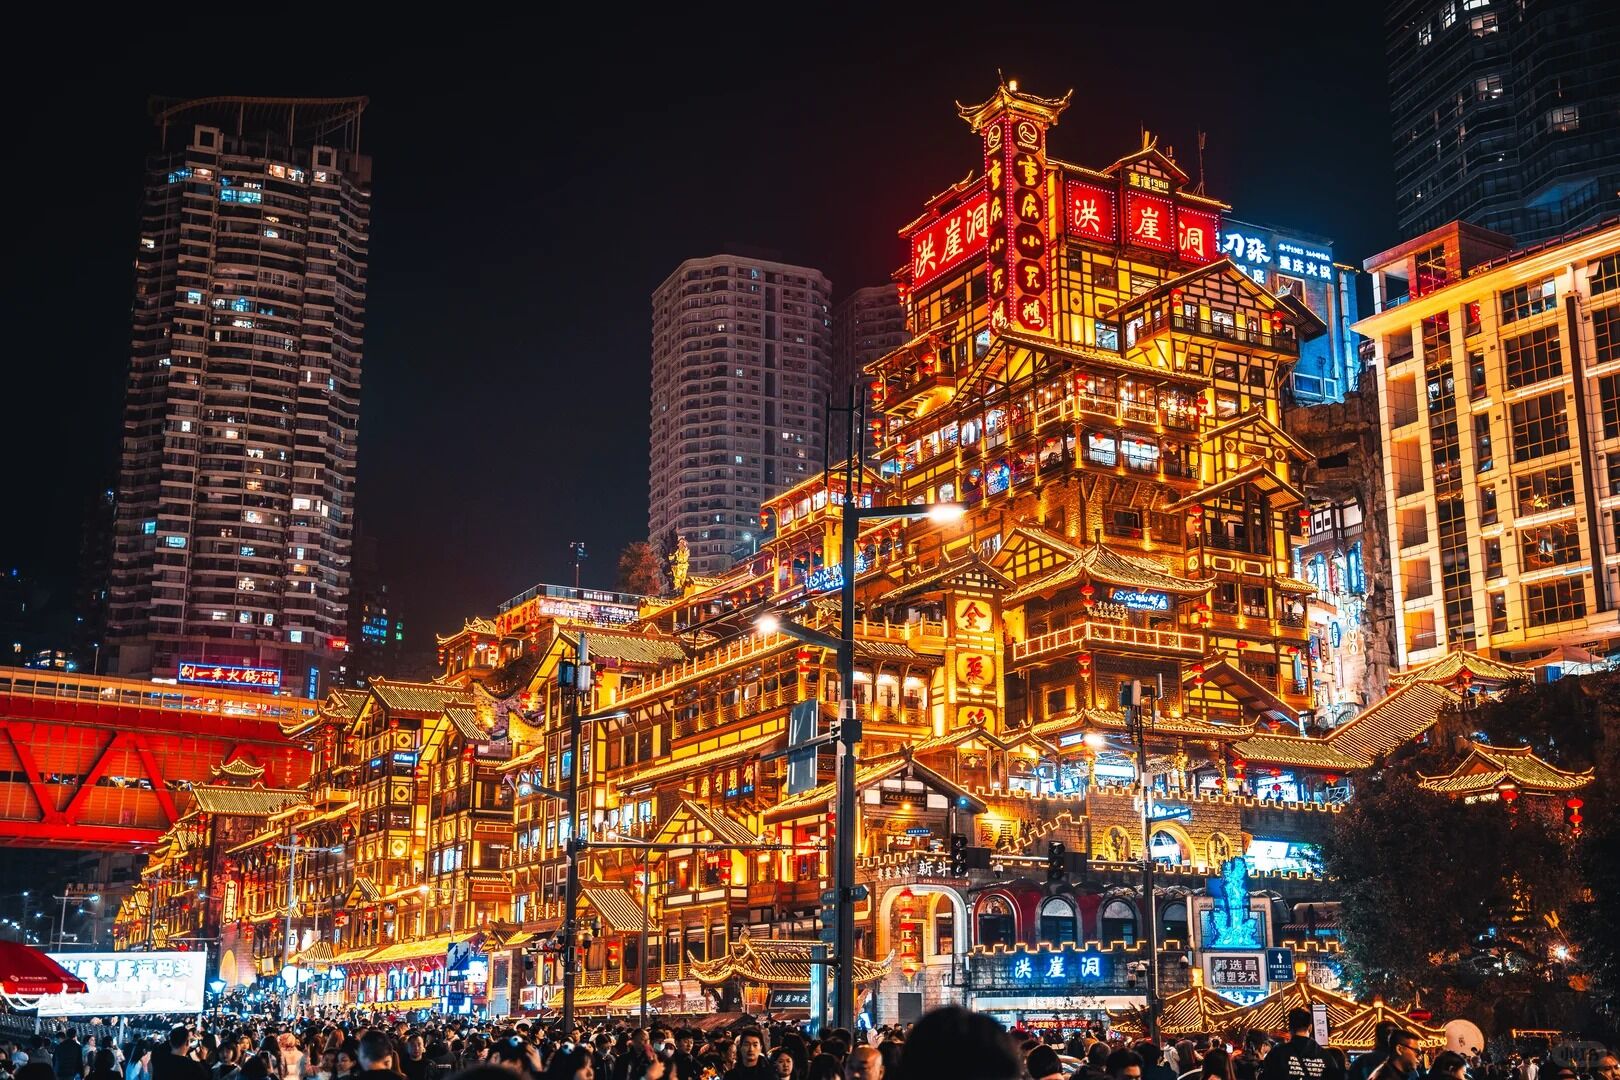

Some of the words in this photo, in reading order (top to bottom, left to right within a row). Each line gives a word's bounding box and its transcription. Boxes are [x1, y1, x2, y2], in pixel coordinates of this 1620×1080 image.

[915, 202, 988, 278] 洪崖洞
[1074, 198, 1204, 257] 洪崖洞
[1279, 255, 1332, 280] 重庆火锅
[917, 860, 969, 878] 新斗
[1014, 955, 1100, 979] 洪崖洞
